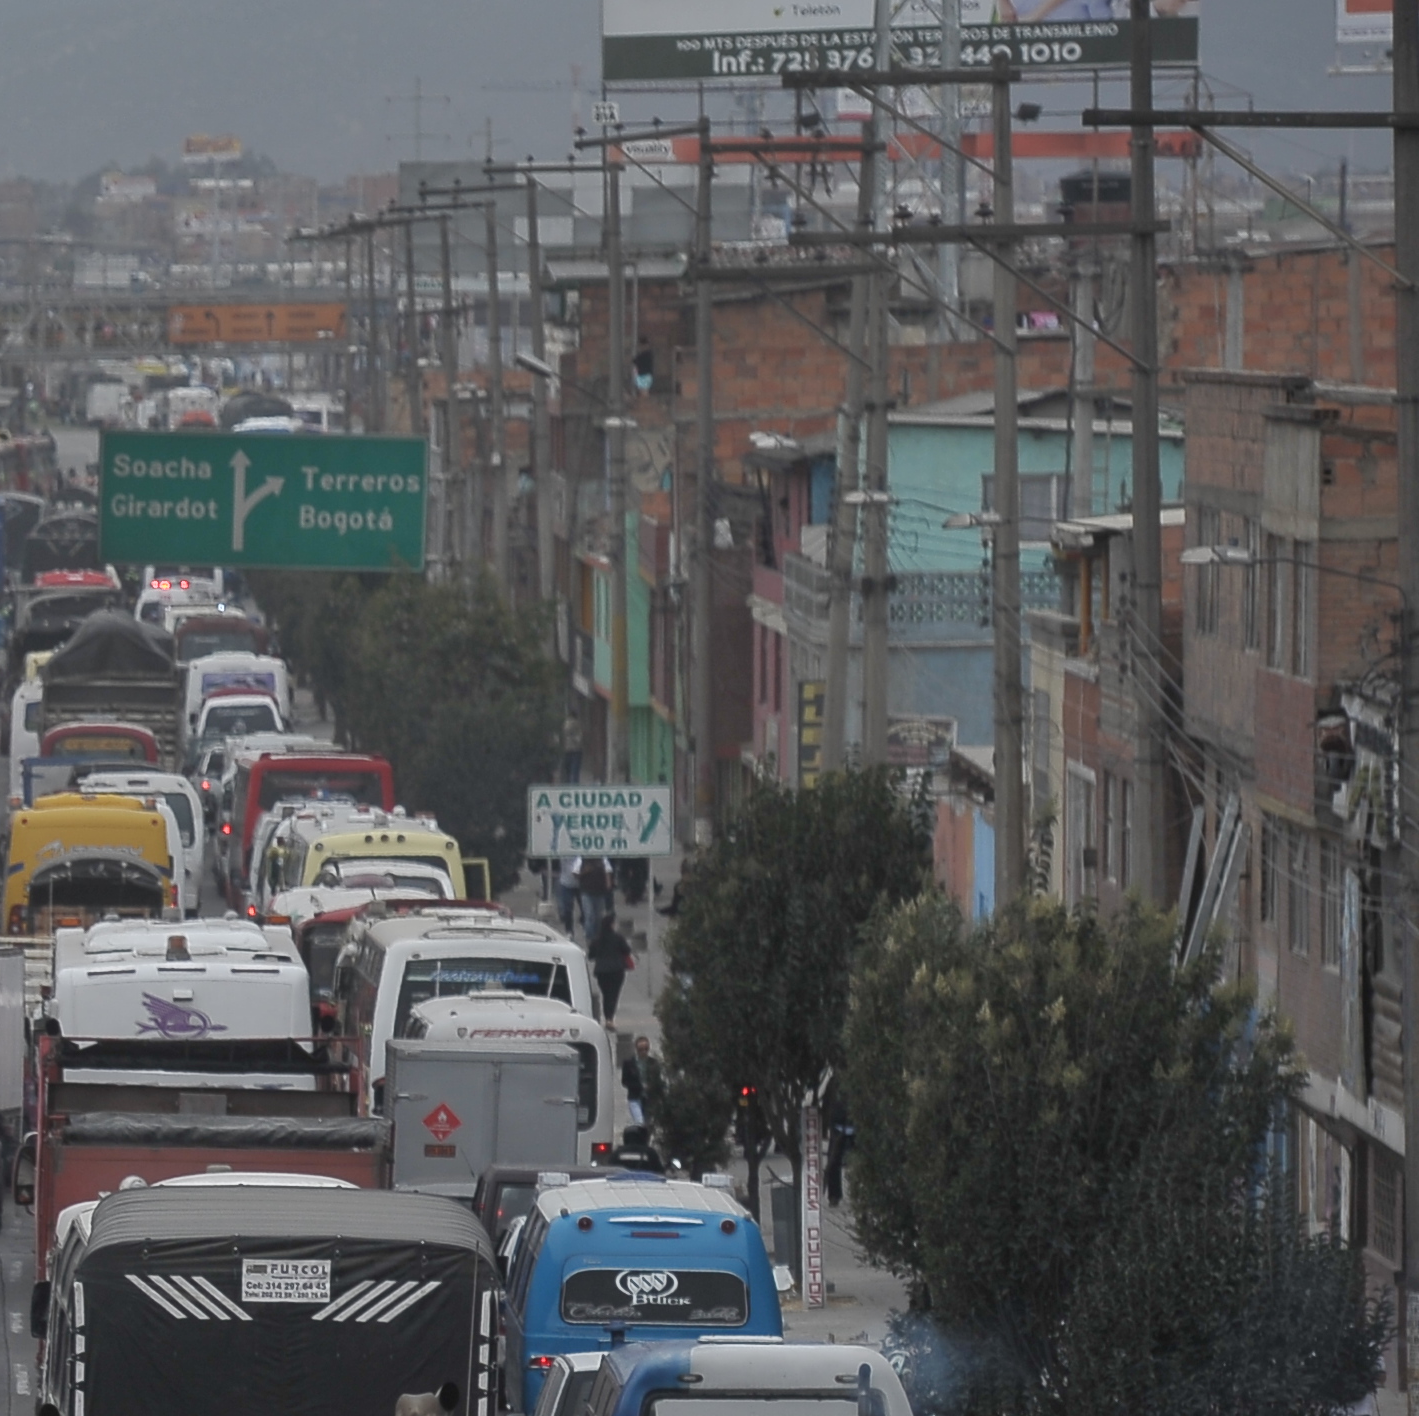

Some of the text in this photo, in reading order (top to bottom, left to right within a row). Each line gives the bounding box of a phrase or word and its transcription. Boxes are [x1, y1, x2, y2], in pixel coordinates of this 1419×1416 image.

[703, 37, 733, 50] MTS
[735, 33, 799, 49] DESPUÉS
[800, 34, 819, 47] DE
[821, 33, 842, 46] LA
[992, 25, 1012, 40] DE
[1014, 22, 1119, 39] TRANSMILENIO
[713, 49, 765, 74] Inf.:
[1019, 41, 1082, 63] 1010
[113, 453, 213, 480] Soacha
[301, 466, 421, 493] Terreros
[111, 494, 219, 520] Girardot
[299, 504, 394, 536] Bogotá
[536, 791, 643, 809] A CIUDAD
[610, 837, 628, 850] m
[807, 1226, 822, 1307] DUCTOS
[265, 1281, 282, 1291] 314
